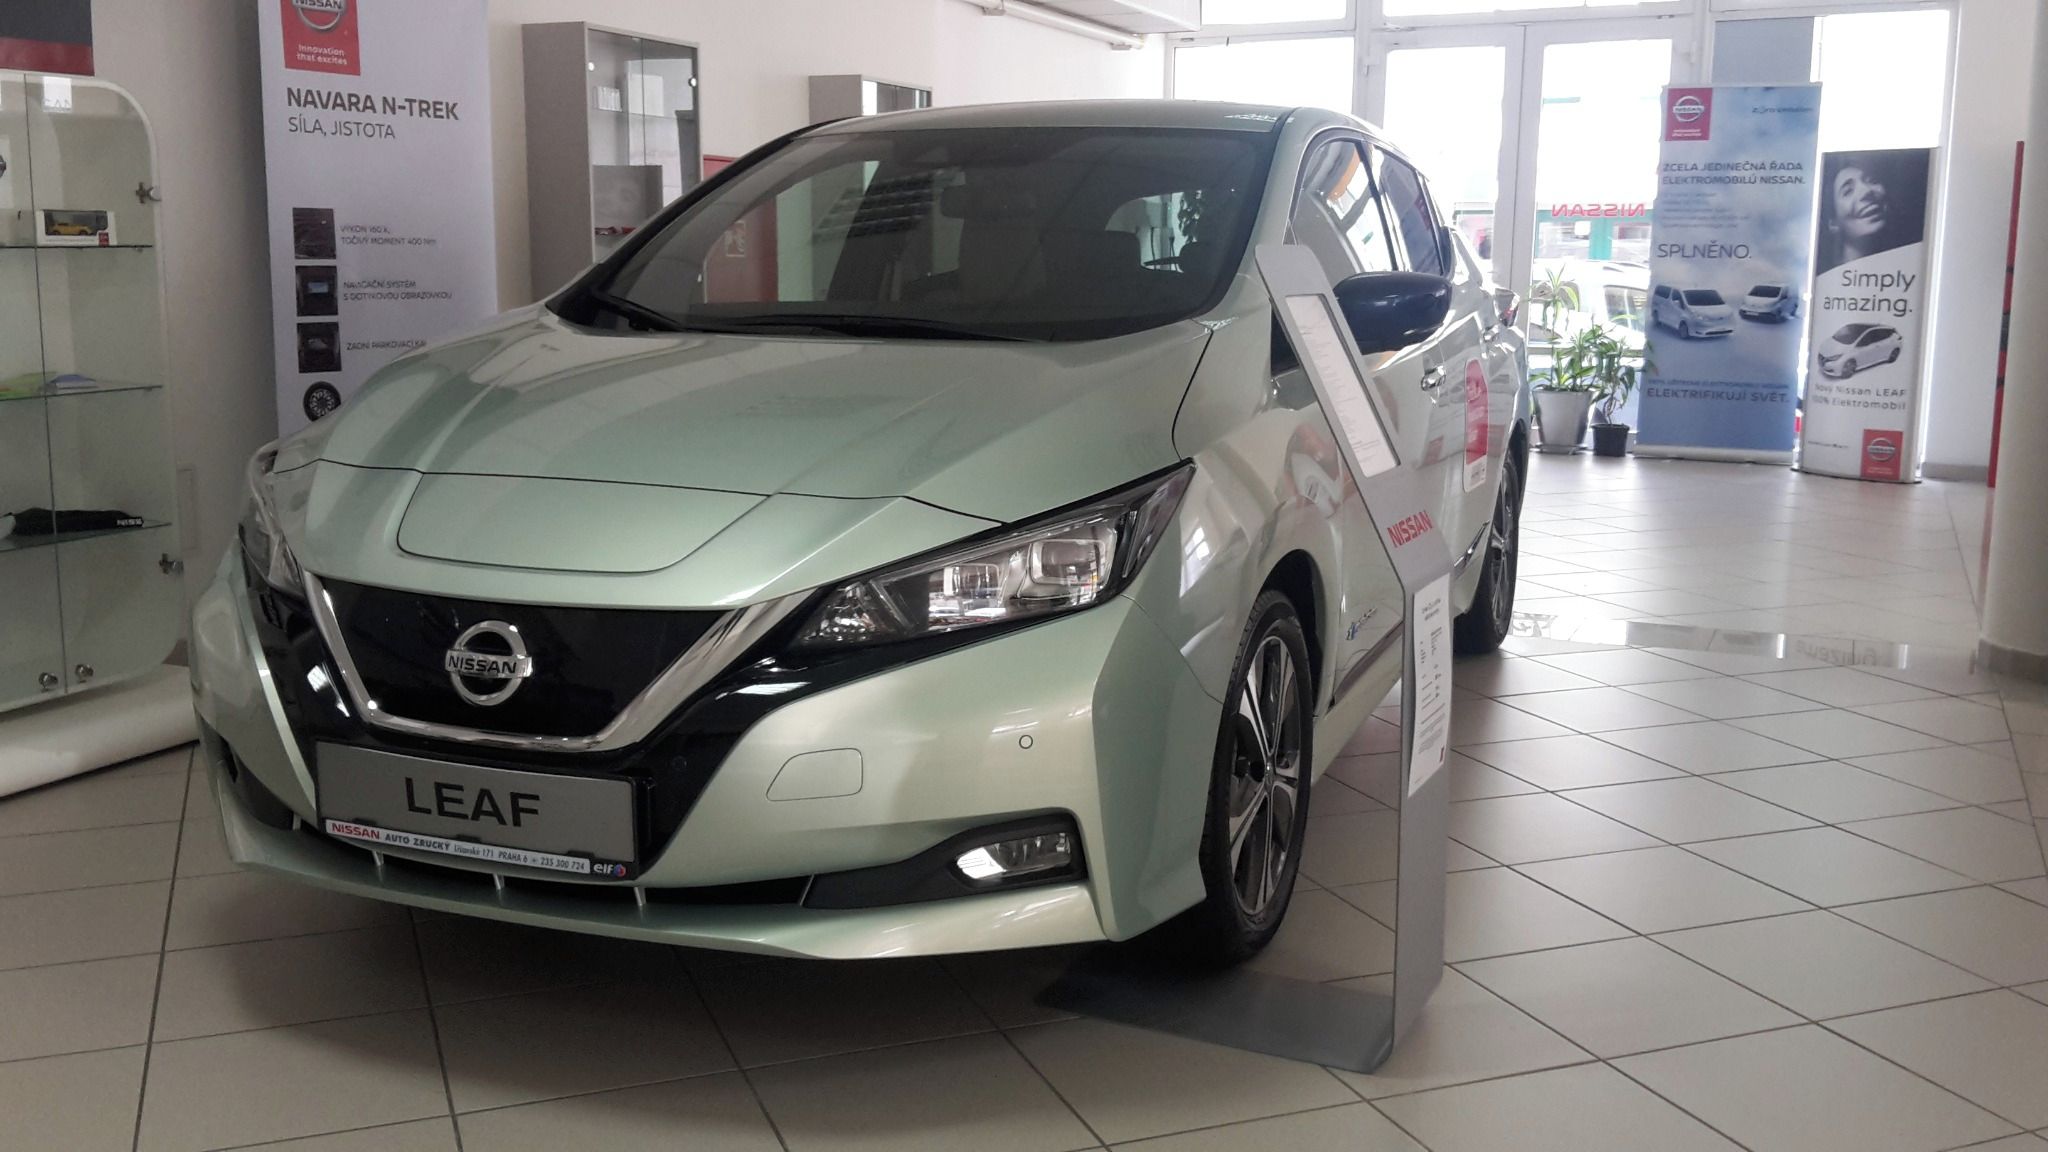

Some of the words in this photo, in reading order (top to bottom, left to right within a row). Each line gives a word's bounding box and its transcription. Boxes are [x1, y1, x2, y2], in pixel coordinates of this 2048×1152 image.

[296, 51, 315, 62] that
[317, 55, 348, 65] excites
[298, 44, 345, 57] Innovation
[287, 87, 377, 114] NAVARA
[382, 96, 459, 120] N-TREK
[288, 113, 327, 137] SÍLA,
[331, 121, 395, 139] JISTOTA
[1663, 162, 1698, 172] ZCELA
[1702, 160, 1767, 171] JEDINEČNÁ
[1769, 160, 1803, 171] ŘADA
[1760, 175, 1805, 185] NISSAN.
[1657, 240, 1752, 259] SPLNĚNO.
[1842, 269, 1916, 292] Simply
[1823, 294, 1912, 317] amazing.
[1647, 387, 1747, 401] ELEKTRIFIKUJÍ
[1836, 385, 1872, 395] Nissan
[1876, 388, 1906, 397] LEAF
[1832, 398, 1906, 410] Elektromobil
[1387, 510, 1433, 548] NISSAN
[448, 655, 517, 674] NISSAN
[404, 776, 541, 828] LEAF
[331, 822, 380, 840] NISSAN
[385, 833, 410, 844] AUTO
[498, 849, 522, 862] PRAHA
[523, 855, 528, 863] 6
[555, 859, 569, 869] 300
[571, 861, 585, 871] 724
[593, 863, 614, 874] elf
